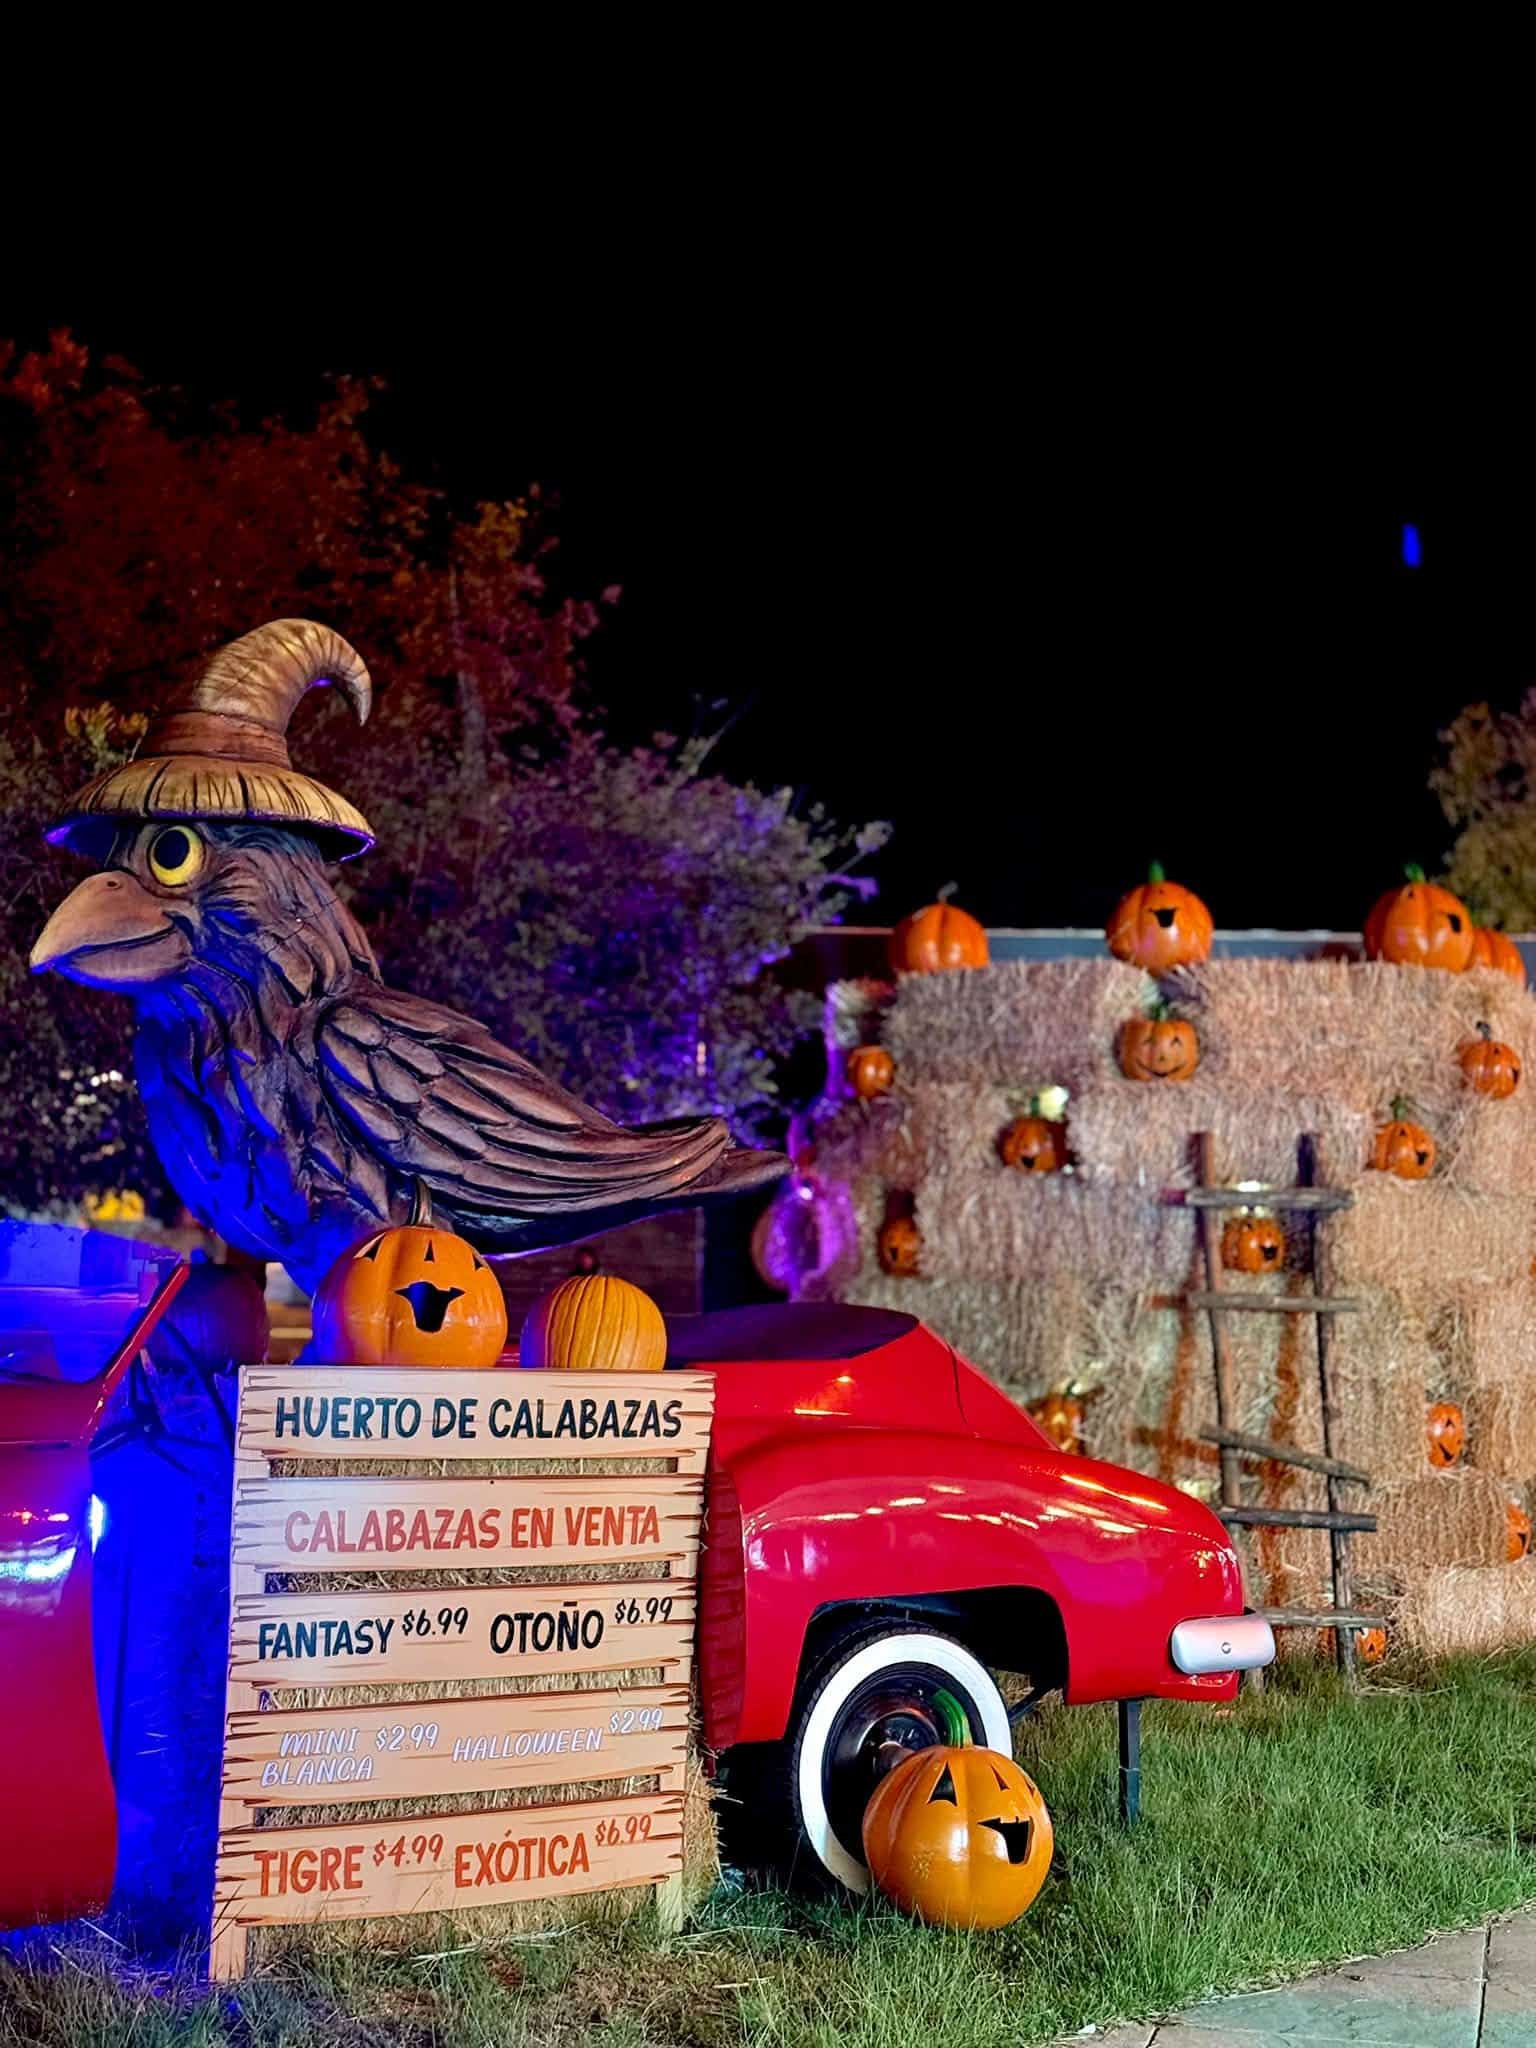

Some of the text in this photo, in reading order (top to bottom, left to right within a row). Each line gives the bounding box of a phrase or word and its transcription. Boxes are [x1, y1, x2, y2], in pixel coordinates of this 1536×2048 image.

[275, 1396, 683, 1439] HUERTO DE CALABAZAS
[284, 1505, 660, 1553] CALABAZAS EN VENTA
[258, 1596, 673, 1660] FANTASY $6.99 OTOÑO $6.99
[279, 1728, 360, 1757] MINI
[376, 1723, 440, 1751] $2.99
[452, 1727, 603, 1763] HALLOWEEN
[261, 1757, 374, 1788] BLANCA
[254, 1814, 652, 1897] TIGRE $4.99 EXÓTICA $6.99
